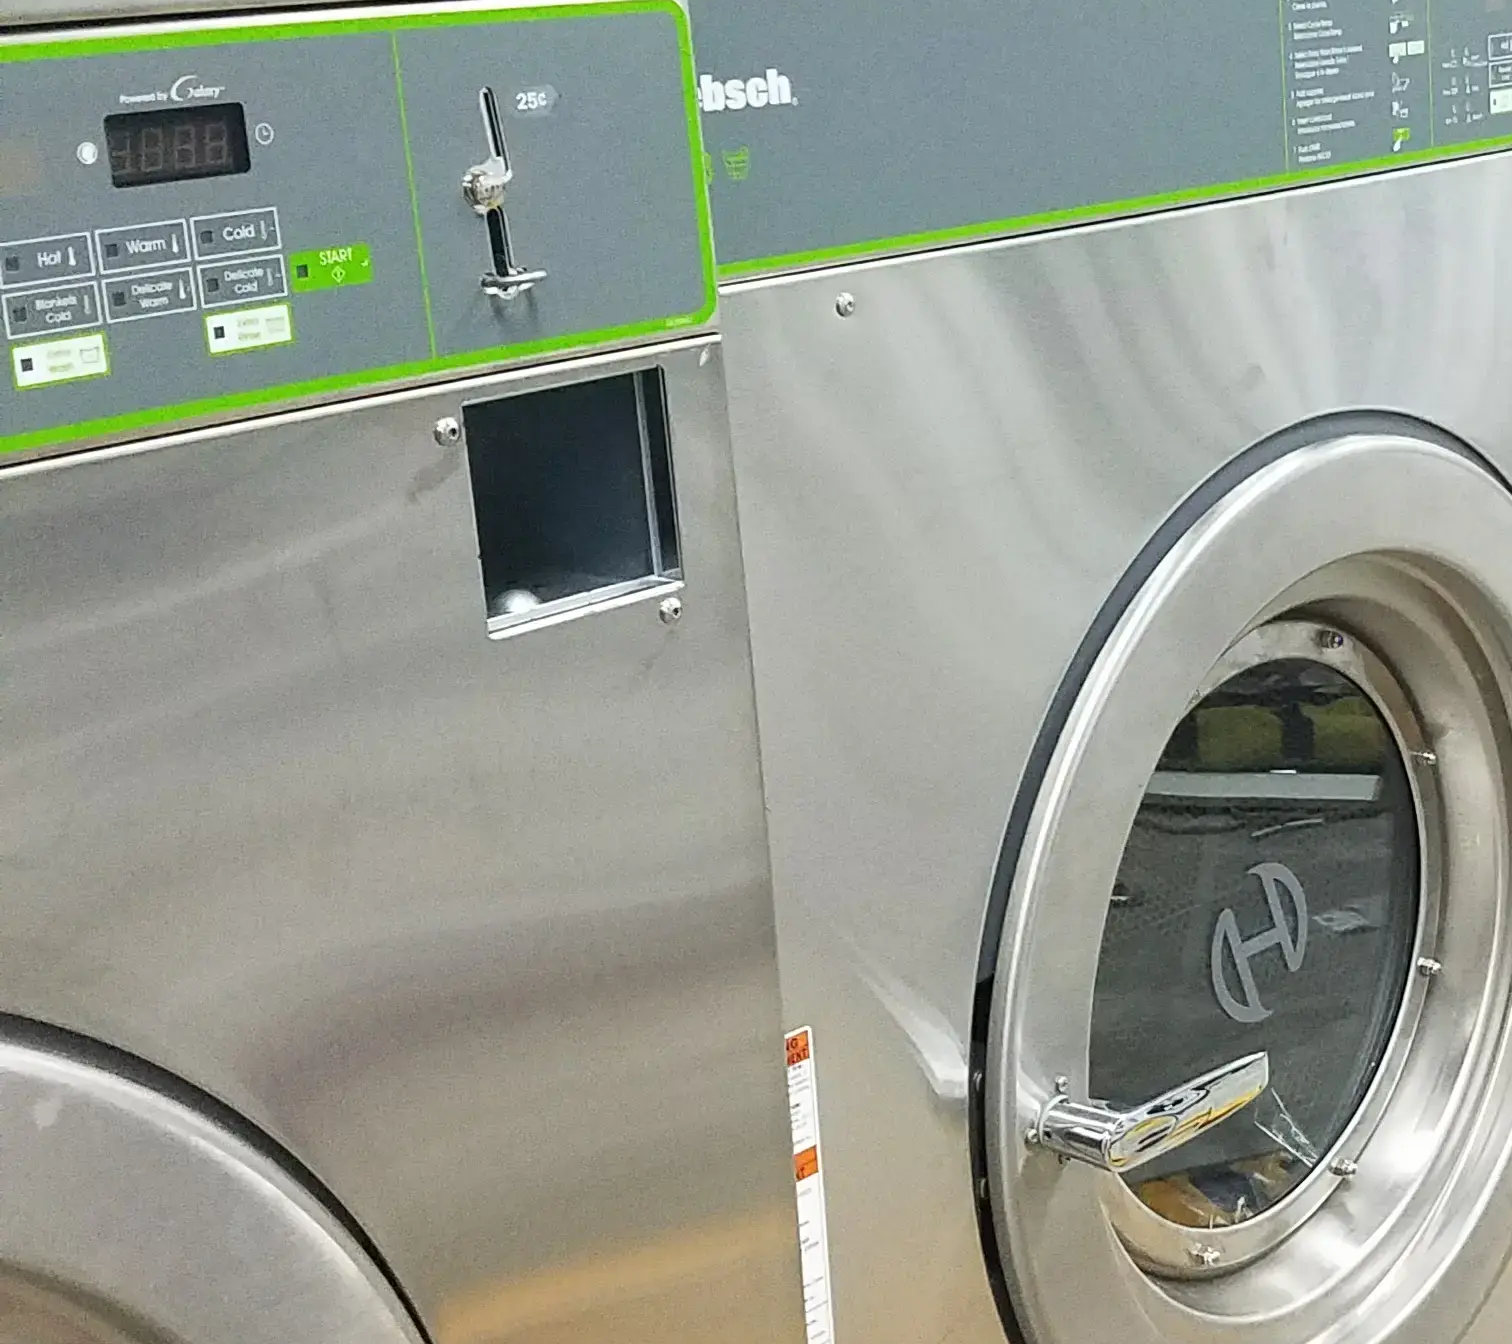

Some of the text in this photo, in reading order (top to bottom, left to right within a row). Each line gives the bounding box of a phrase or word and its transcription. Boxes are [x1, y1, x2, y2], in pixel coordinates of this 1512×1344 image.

[516, 91, 547, 110] 25¢
[222, 224, 255, 242] Cold
[125, 238, 167, 254] Warm
[37, 250, 62, 268] Hot
[319, 247, 353, 266] START
[224, 267, 264, 282] Delicate
[234, 280, 258, 294] Cold
[138, 296, 169, 309] Warm
[45, 310, 72, 324] Cold
